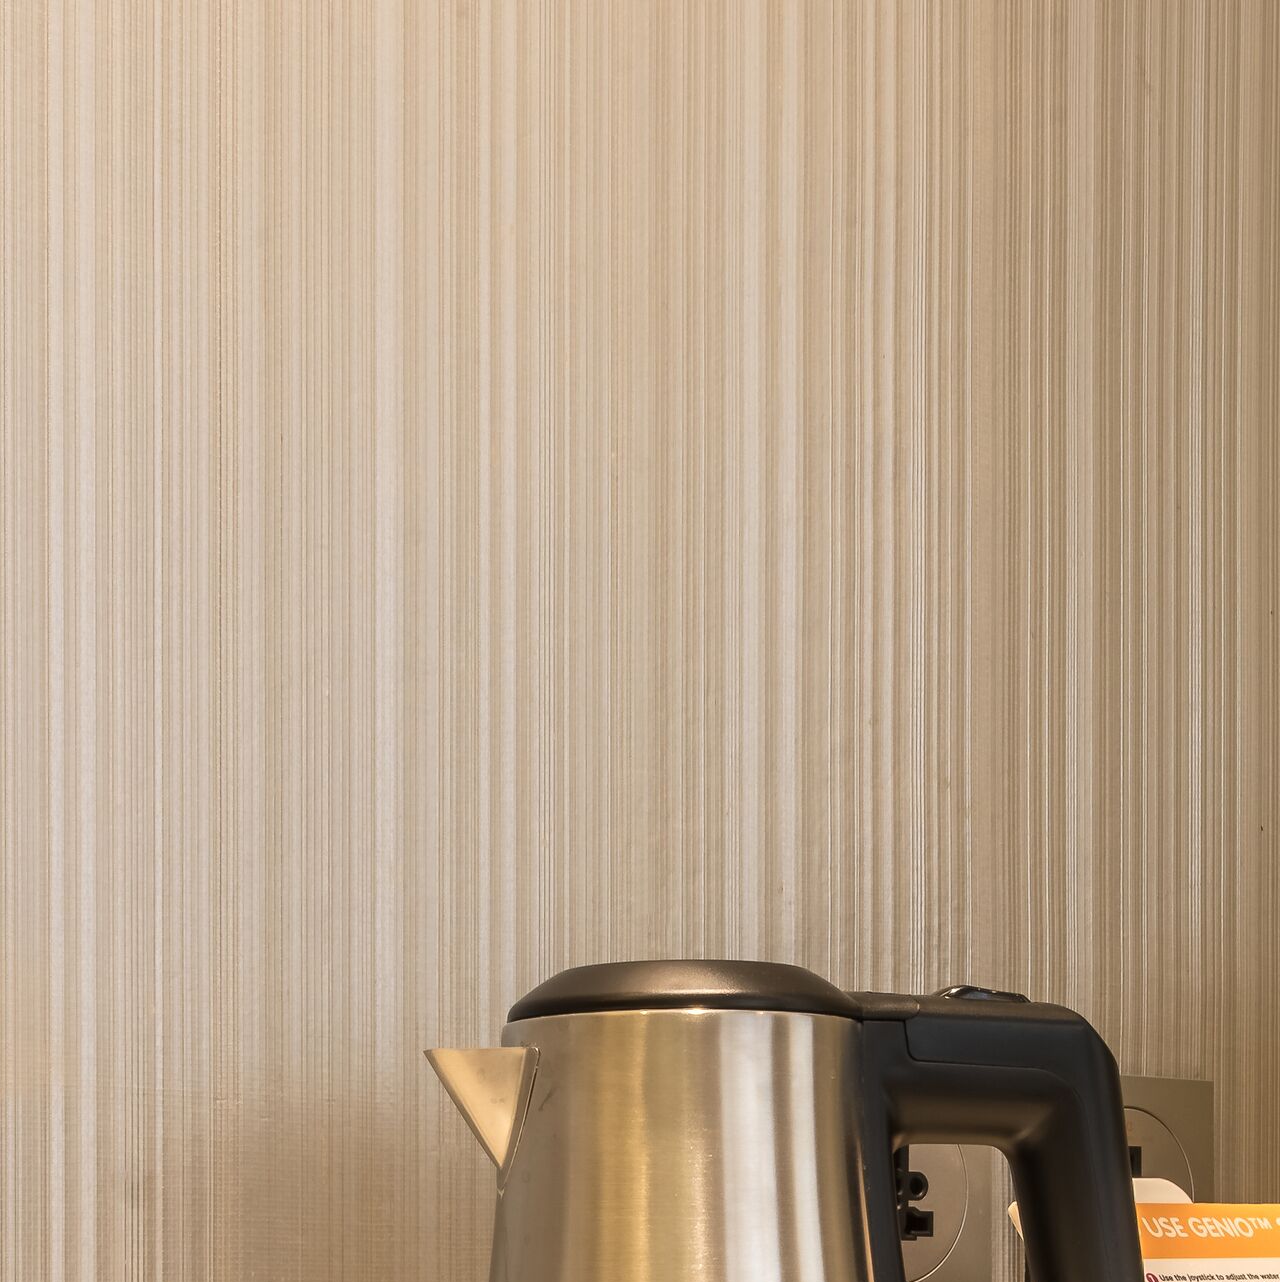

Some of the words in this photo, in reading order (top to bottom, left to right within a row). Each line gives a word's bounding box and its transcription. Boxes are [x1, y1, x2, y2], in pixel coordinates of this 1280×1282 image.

[1141, 1217, 1189, 1238] USE
[1174, 1273, 1187, 1281] the
[1187, 1273, 1215, 1282] joystick
[1226, 1272, 1247, 1281] adjust
[1247, 1272, 1260, 1280] the
[1260, 1272, 1280, 1280] water
